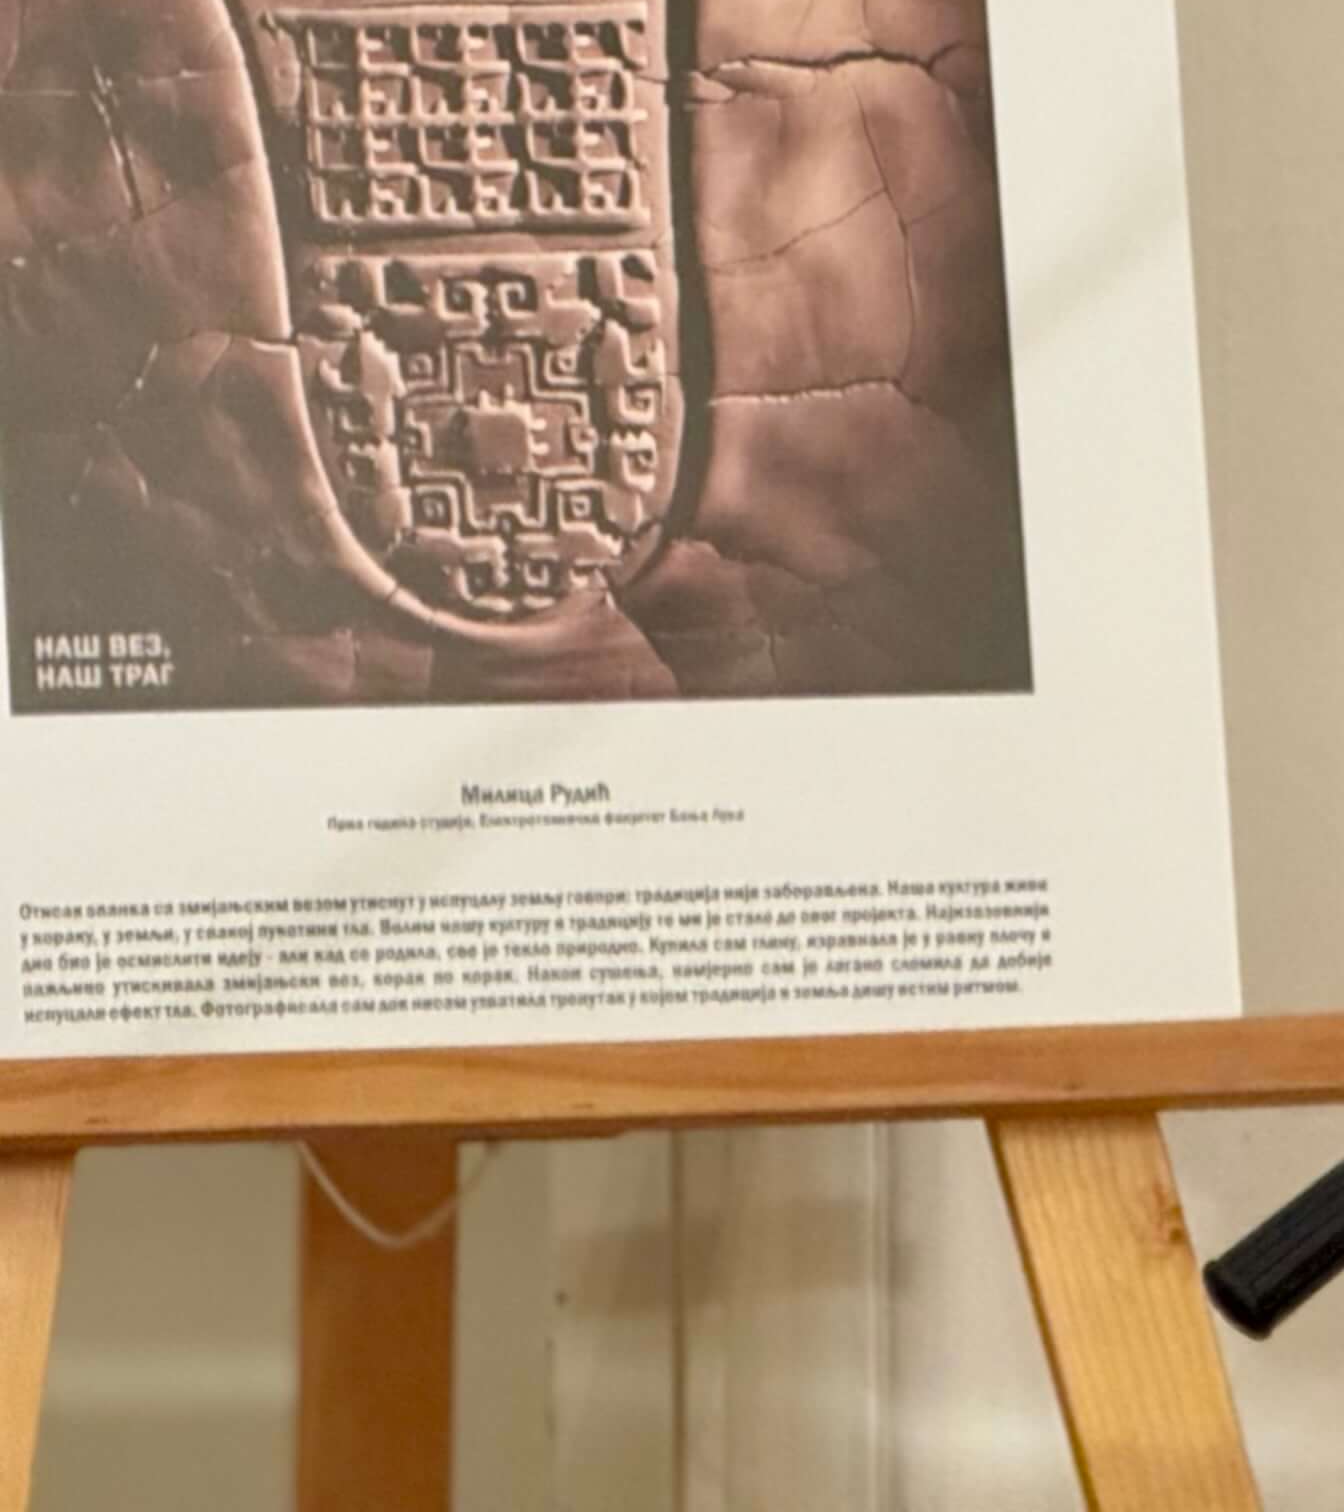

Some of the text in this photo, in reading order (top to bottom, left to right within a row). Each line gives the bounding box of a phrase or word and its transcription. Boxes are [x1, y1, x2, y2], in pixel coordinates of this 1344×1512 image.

[34, 632, 172, 659] НАШ ВЕЗ,
[36, 663, 175, 689] НАШ ТРАГ
[461, 782, 610, 805] Милица Рудић
